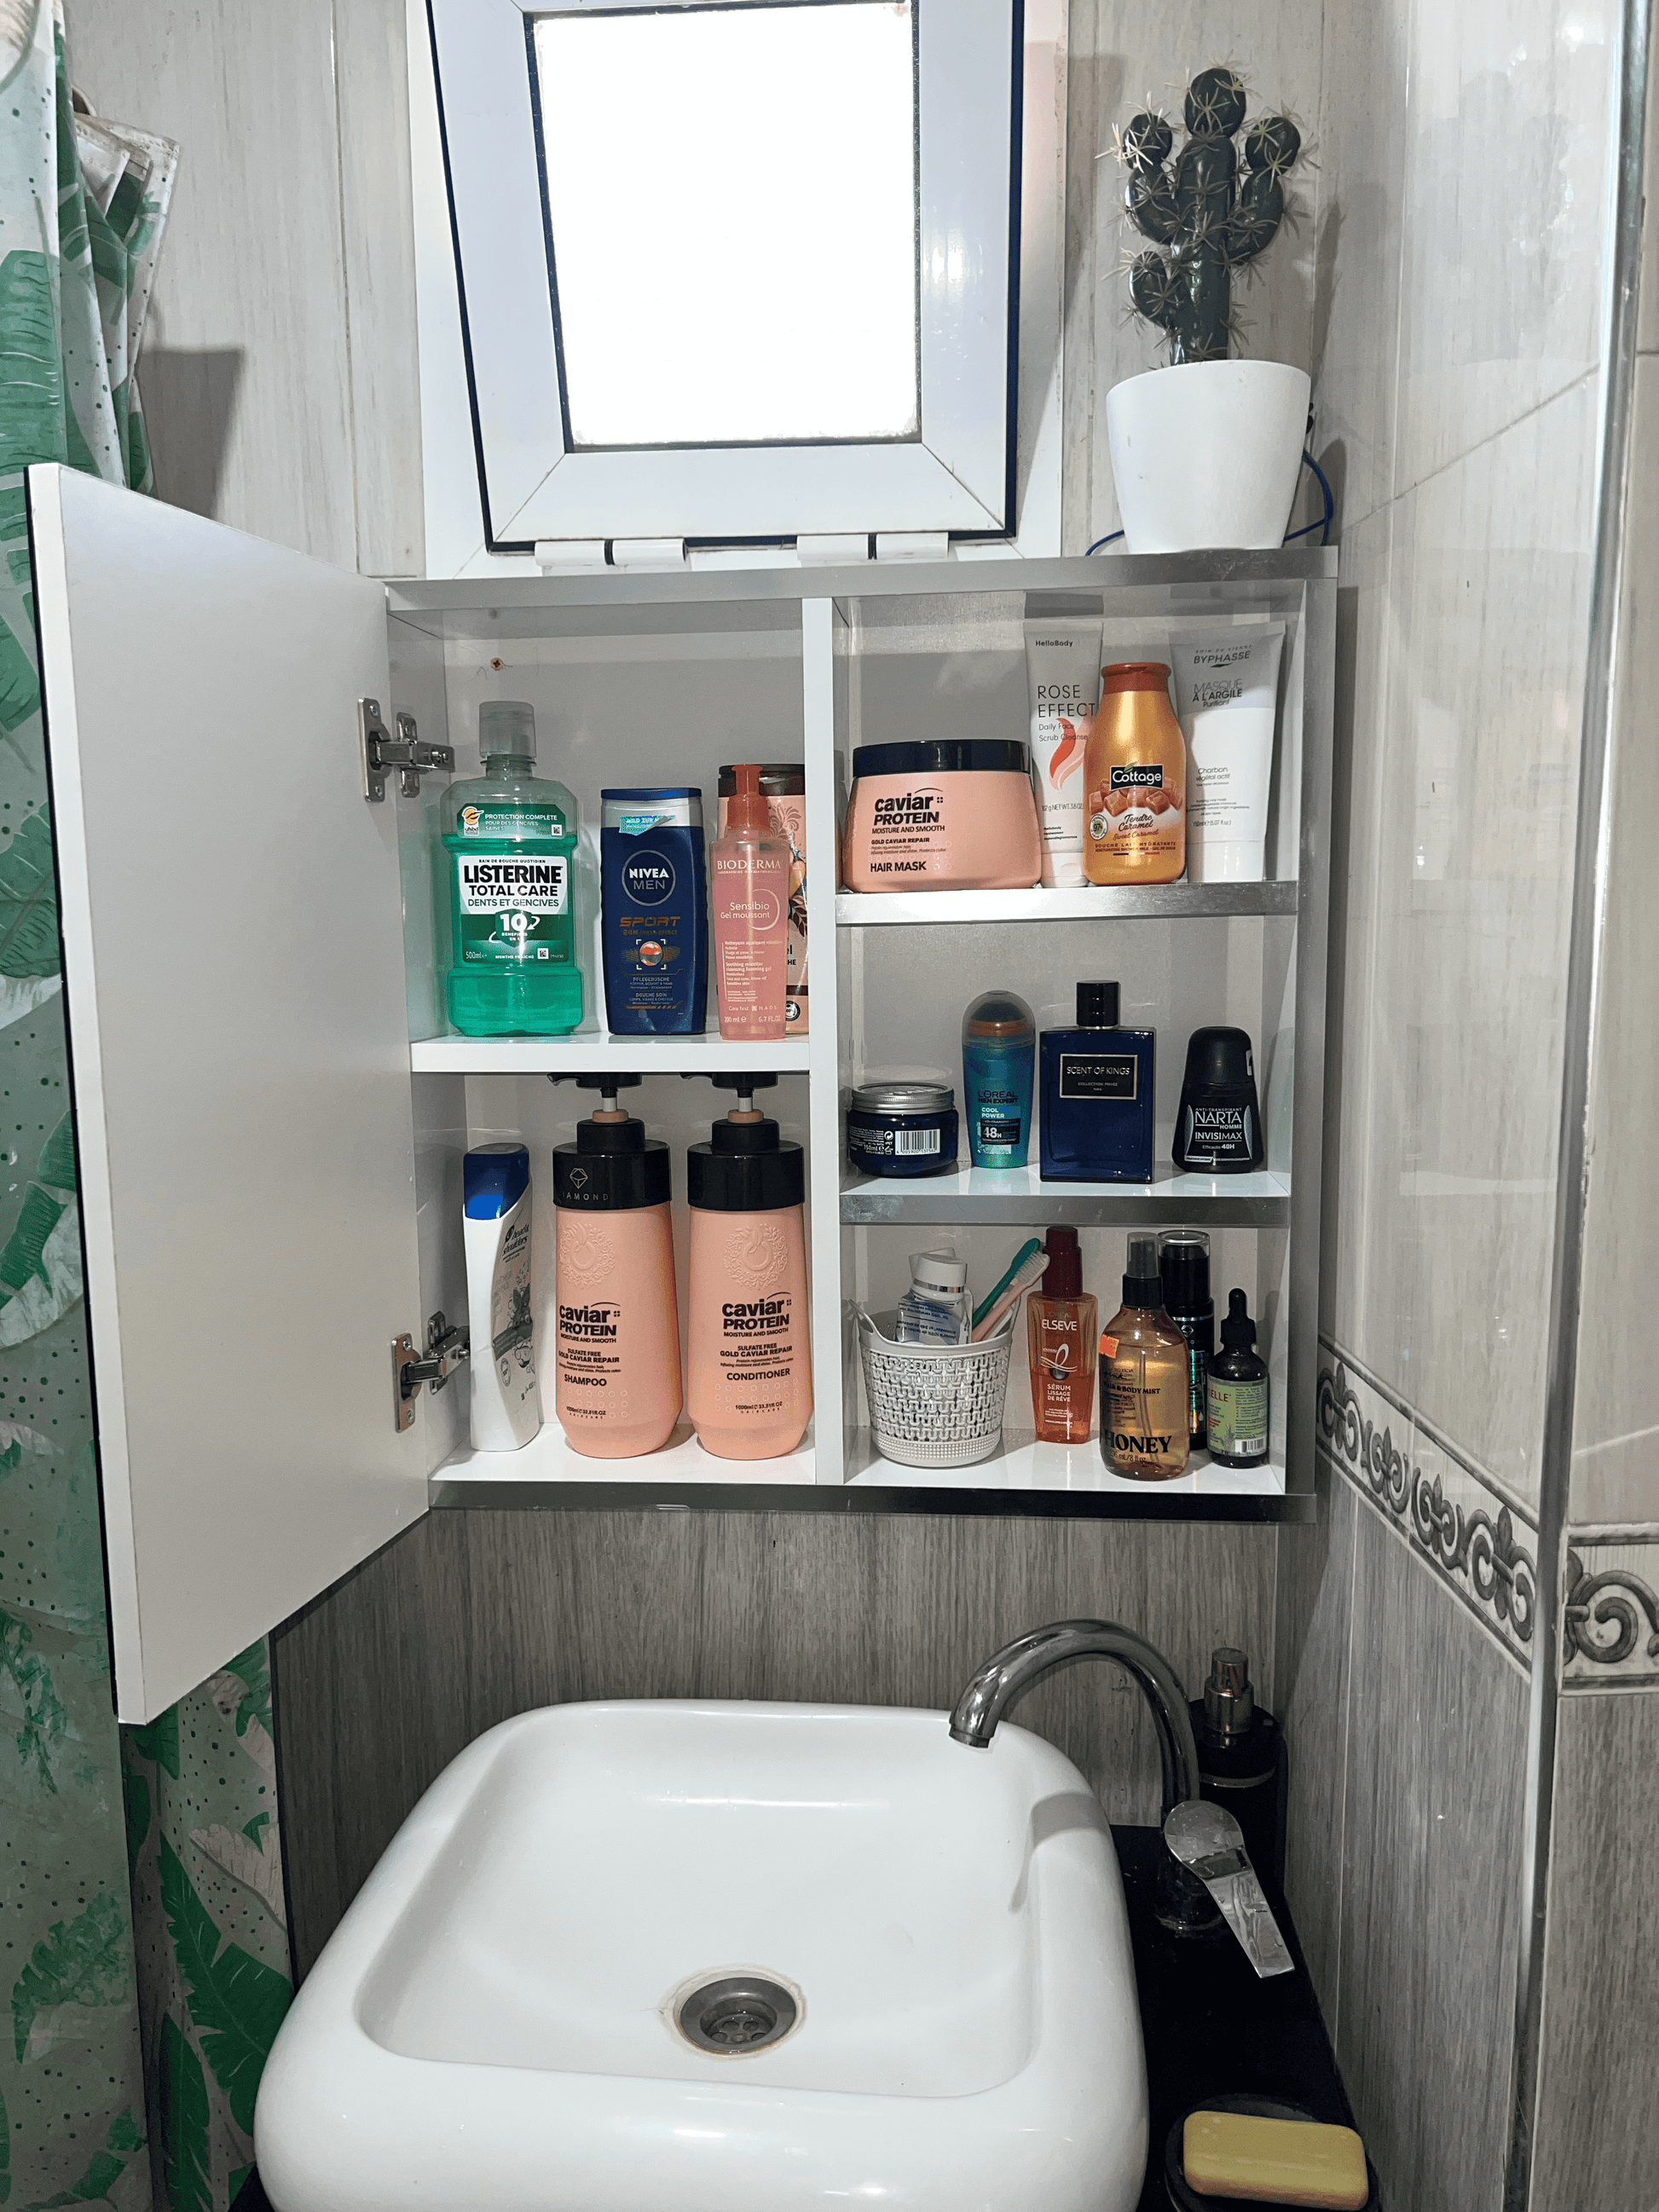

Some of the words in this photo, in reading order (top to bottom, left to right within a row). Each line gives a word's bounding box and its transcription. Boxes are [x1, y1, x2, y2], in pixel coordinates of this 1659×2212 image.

[1194, 650, 1251, 664] BYPHASSE
[1038, 684, 1080, 699] ROSE
[1194, 679, 1242, 693] MASQUE
[1201, 689, 1242, 702] L'ARGILE
[1038, 702, 1095, 718] EFFECT
[1112, 770, 1161, 785] Cottage
[875, 792, 934, 812] caviar
[873, 811, 939, 826] PROTEIN
[1124, 814, 1153, 824] Tendre
[1118, 819, 1153, 832] Caramel
[717, 859, 781, 870] BIODERMA
[870, 863, 893, 872] HAIR
[894, 861, 927, 871] MASK
[464, 864, 562, 883] LISTERINE
[628, 868, 669, 879] NIVEA
[468, 885, 514, 896] TOTAL
[517, 885, 558, 897] CARE
[633, 880, 665, 890] MEN
[512, 898, 559, 907] GENCIVES
[730, 901, 770, 910] Sensibio
[500, 913, 528, 931] 10
[619, 916, 681, 927] SPORT
[1066, 1066, 1092, 1075] SCENT
[1093, 1066, 1105, 1075] OF
[1106, 1067, 1130, 1076] KINGS
[1195, 1112, 1242, 1124] NARTA
[983, 1126, 1002, 1139] 48H
[1194, 1131, 1243, 1141] INVISIMAX
[722, 1298, 784, 1317] caviar
[559, 1305, 611, 1324] caviar
[723, 1313, 789, 1330] PROTEIN
[1041, 1319, 1078, 1331] ELSEVE
[559, 1319, 617, 1337] PROTEIN
[766, 1326, 789, 1336] SMOOTH
[560, 1332, 580, 1342] MOISTURE
[567, 1348, 587, 1356] SULFATE
[769, 1345, 793, 1355] REPAIR
[569, 1354, 592, 1363] CAVIAR
[564, 1373, 607, 1387] SHAMPOO
[726, 1367, 790, 1381] CONDITIONER
[1122, 1386, 1142, 1395] BODY
[1104, 1429, 1172, 1454] HONEY
